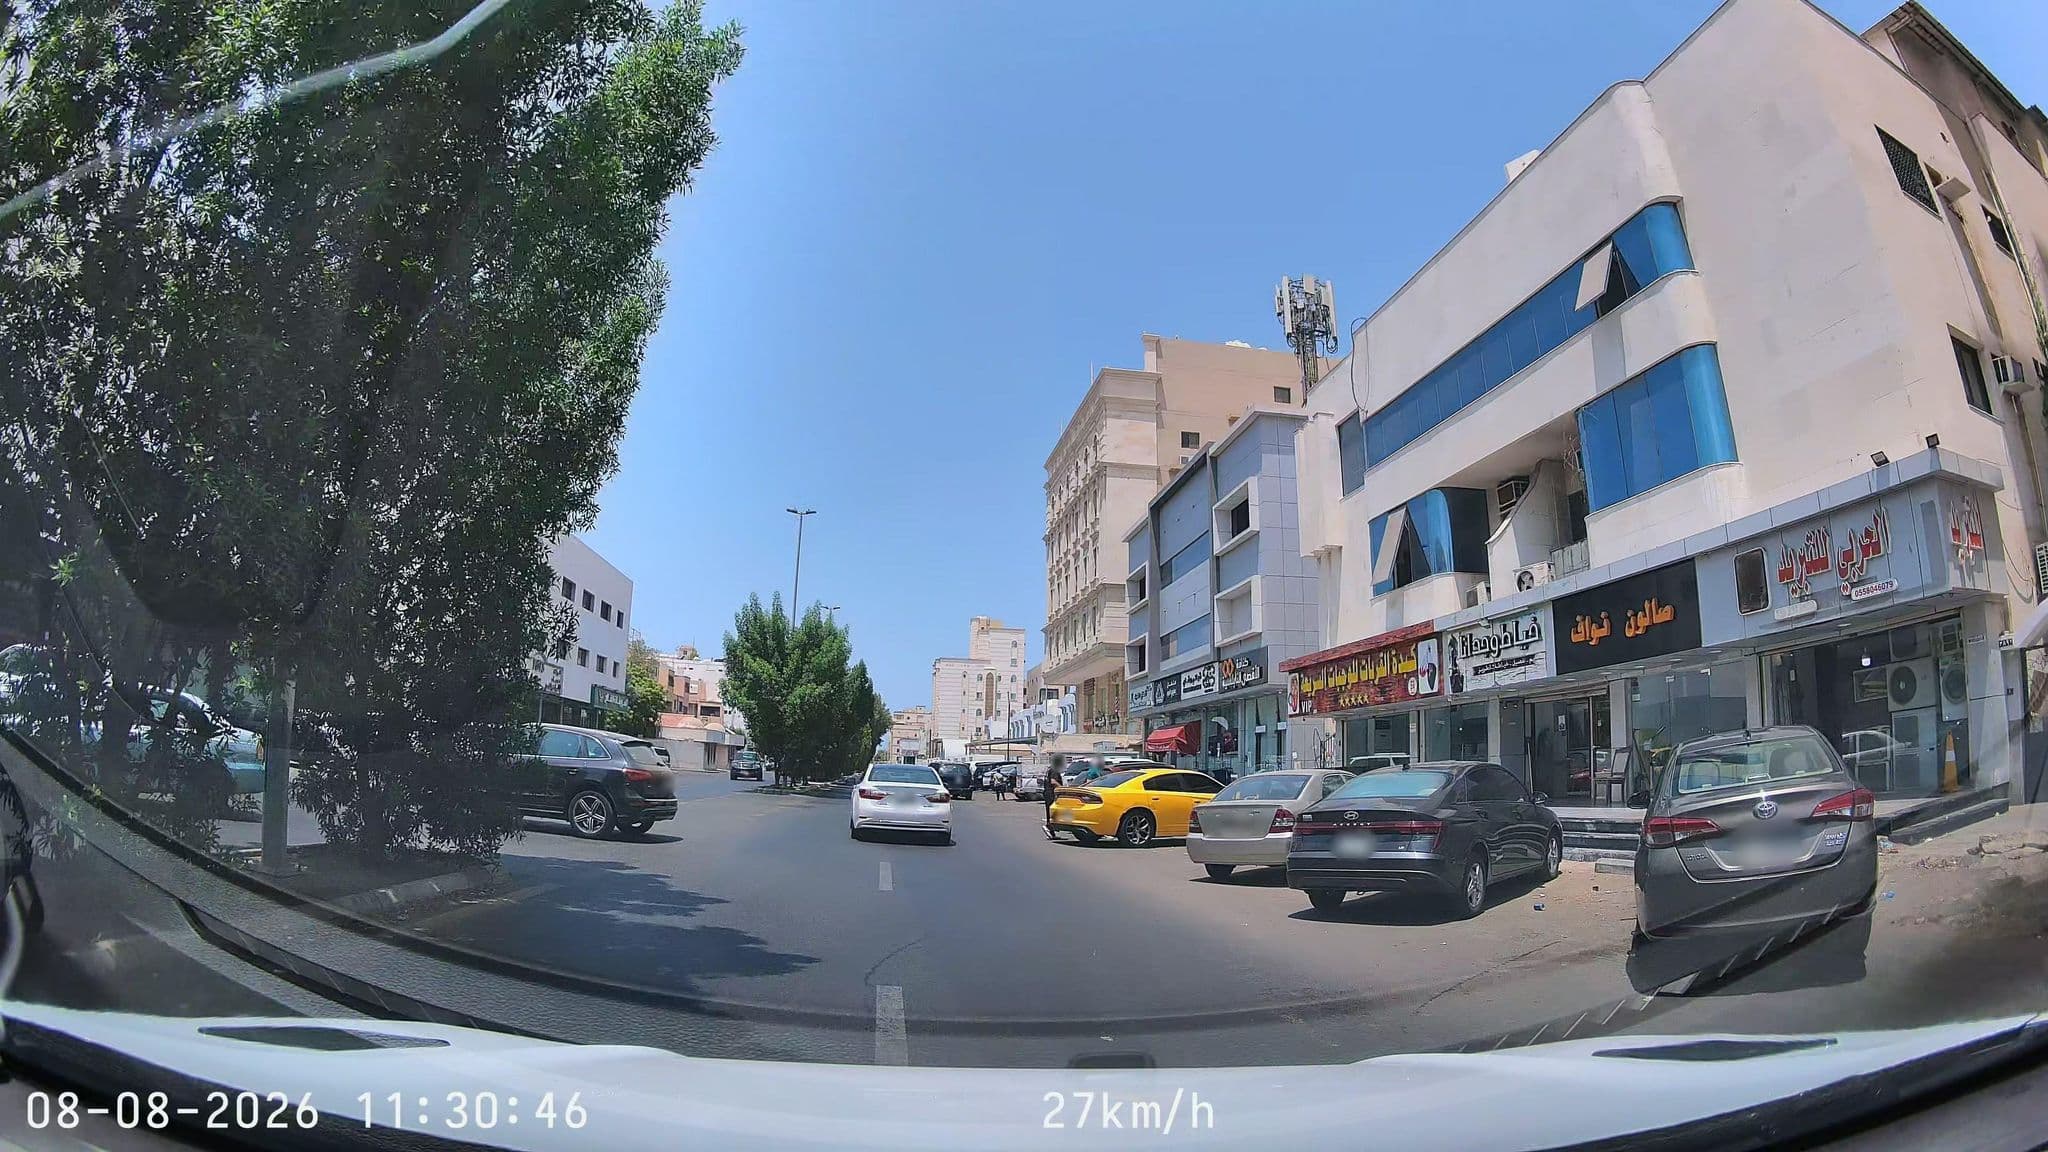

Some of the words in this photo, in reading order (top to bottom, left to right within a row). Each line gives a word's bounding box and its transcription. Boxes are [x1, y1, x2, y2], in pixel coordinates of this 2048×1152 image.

[1776, 526, 1831, 598] للتبريد
[1836, 506, 1892, 596] العربي
[1500, 615, 1543, 650] خياط
[1570, 611, 1612, 646] نواف
[1625, 596, 1675, 638] صالون
[1392, 643, 1418, 679] كبدة
[1300, 664, 1327, 697] السريعة
[1301, 701, 1312, 713] VIP
